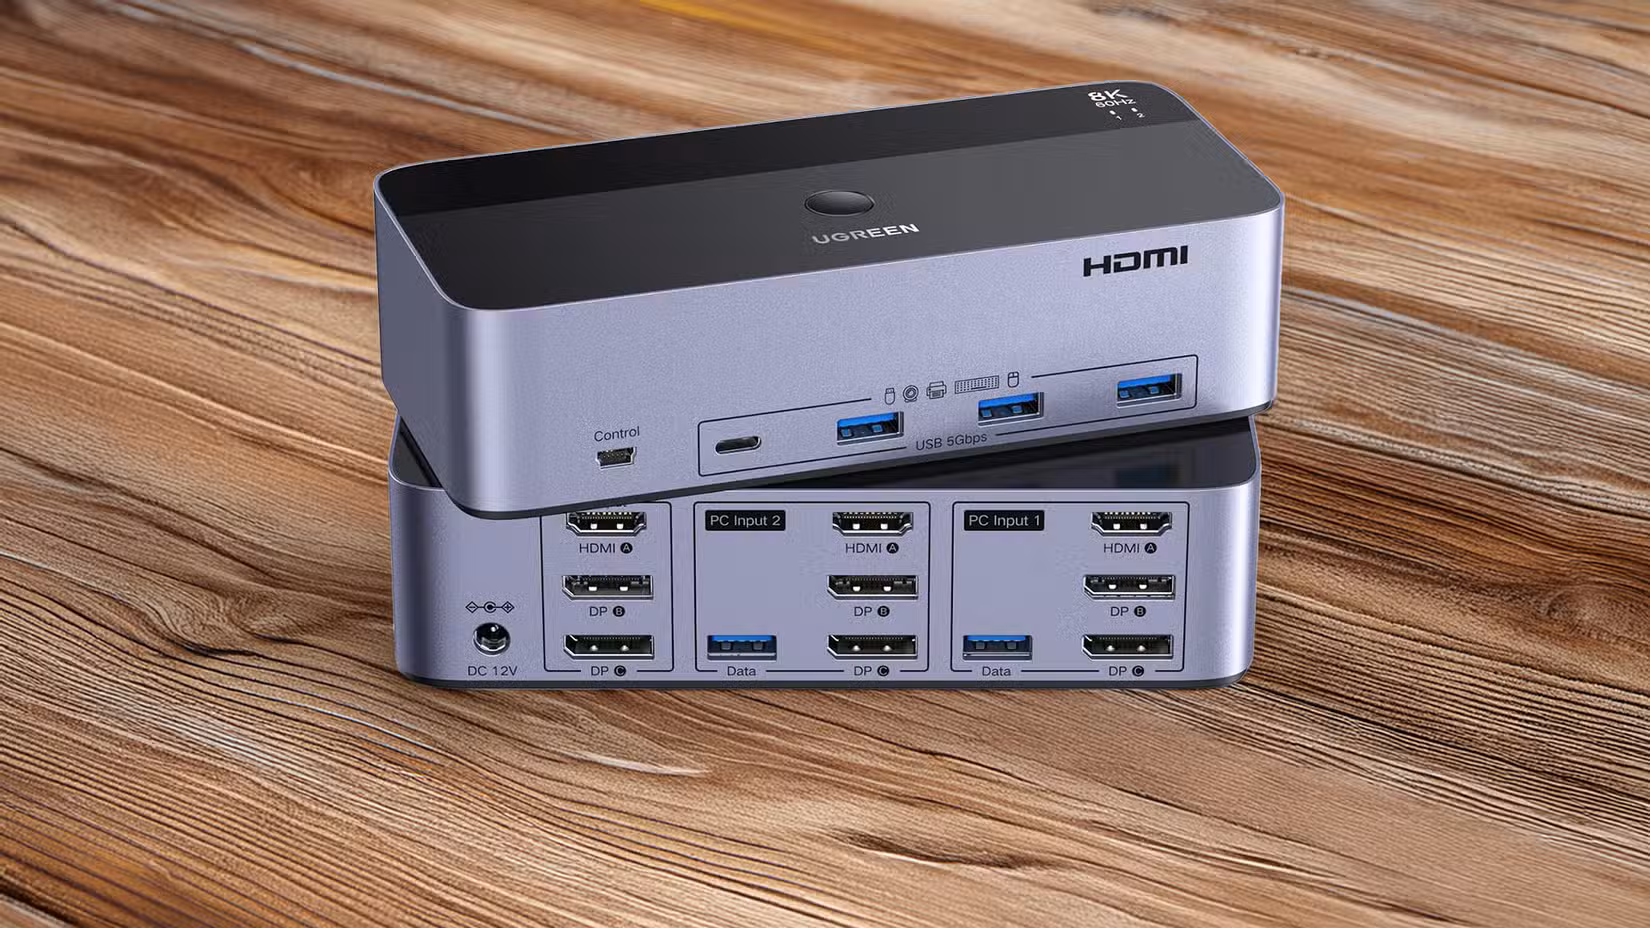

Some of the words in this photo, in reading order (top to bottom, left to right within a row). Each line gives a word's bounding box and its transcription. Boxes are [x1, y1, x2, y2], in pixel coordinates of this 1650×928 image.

[1088, 89, 1128, 101] 8K
[1095, 99, 1136, 108] 60Hz
[812, 223, 920, 244] UGREEN
[1083, 245, 1189, 277] HDMI
[593, 425, 640, 442] Control
[916, 437, 942, 451] USB
[947, 433, 988, 446] 5Gbps
[710, 515, 730, 526] PC
[734, 515, 768, 527] Input
[772, 515, 781, 526] 2
[969, 515, 989, 526] PC
[994, 515, 1028, 527] Input
[1034, 515, 1041, 526] 1
[579, 543, 616, 553] HDMI
[621, 543, 632, 553] A
[845, 543, 882, 553] HDMI
[887, 543, 898, 553] A
[1103, 543, 1140, 553] HDMI
[1145, 543, 1156, 553] A
[589, 606, 607, 617] DP
[614, 606, 625, 617] B
[854, 606, 872, 617] DP
[878, 606, 889, 617] B
[1110, 606, 1128, 617] DP
[1135, 606, 1146, 617] B
[467, 666, 488, 676] DC
[492, 666, 518, 676] 12V
[591, 666, 609, 676] DP
[615, 666, 626, 676] C
[727, 666, 756, 676] Data
[854, 666, 872, 676] DP
[878, 666, 889, 676] C
[982, 666, 1011, 676] Data
[1109, 666, 1127, 676] DP
[1133, 666, 1144, 676] C
